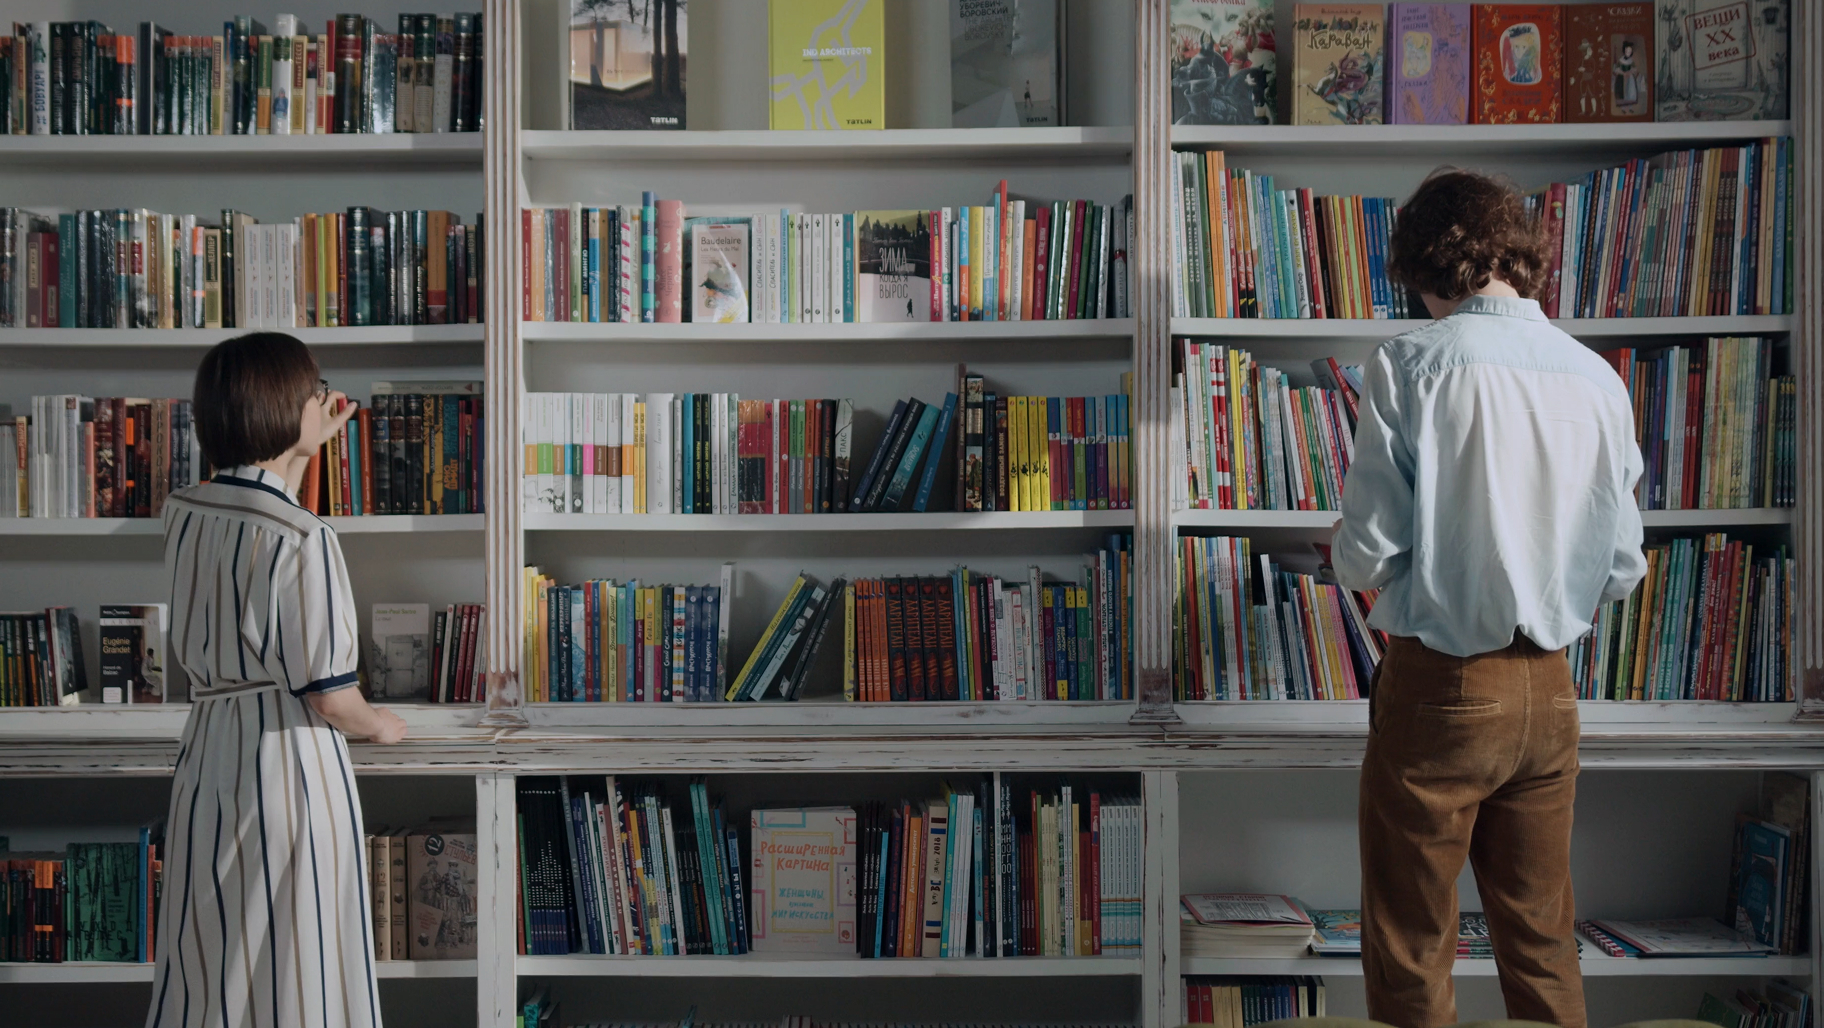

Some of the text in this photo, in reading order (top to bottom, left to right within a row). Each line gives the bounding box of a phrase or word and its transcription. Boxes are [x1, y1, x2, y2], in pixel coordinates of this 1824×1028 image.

[960, 6, 1008, 18] БОРОВСКИЙ
[1695, 9, 1740, 30] ВЕЩИ
[1708, 47, 1740, 61] века
[701, 237, 742, 246] Baudelaire
[879, 247, 908, 273] ЗИМА
[880, 284, 909, 299] ВЫРОС
[449, 458, 457, 491] ШМИДТ
[103, 637, 131, 647] Eugénie
[103, 646, 132, 654] Grandet
[426, 837, 442, 852] 12
[910, 829, 918, 867] университет
[933, 837, 941, 856] 2018
[779, 887, 824, 900] ЖЕНЩИНЫ
[771, 909, 835, 920] МИР ИСКУССТВА
